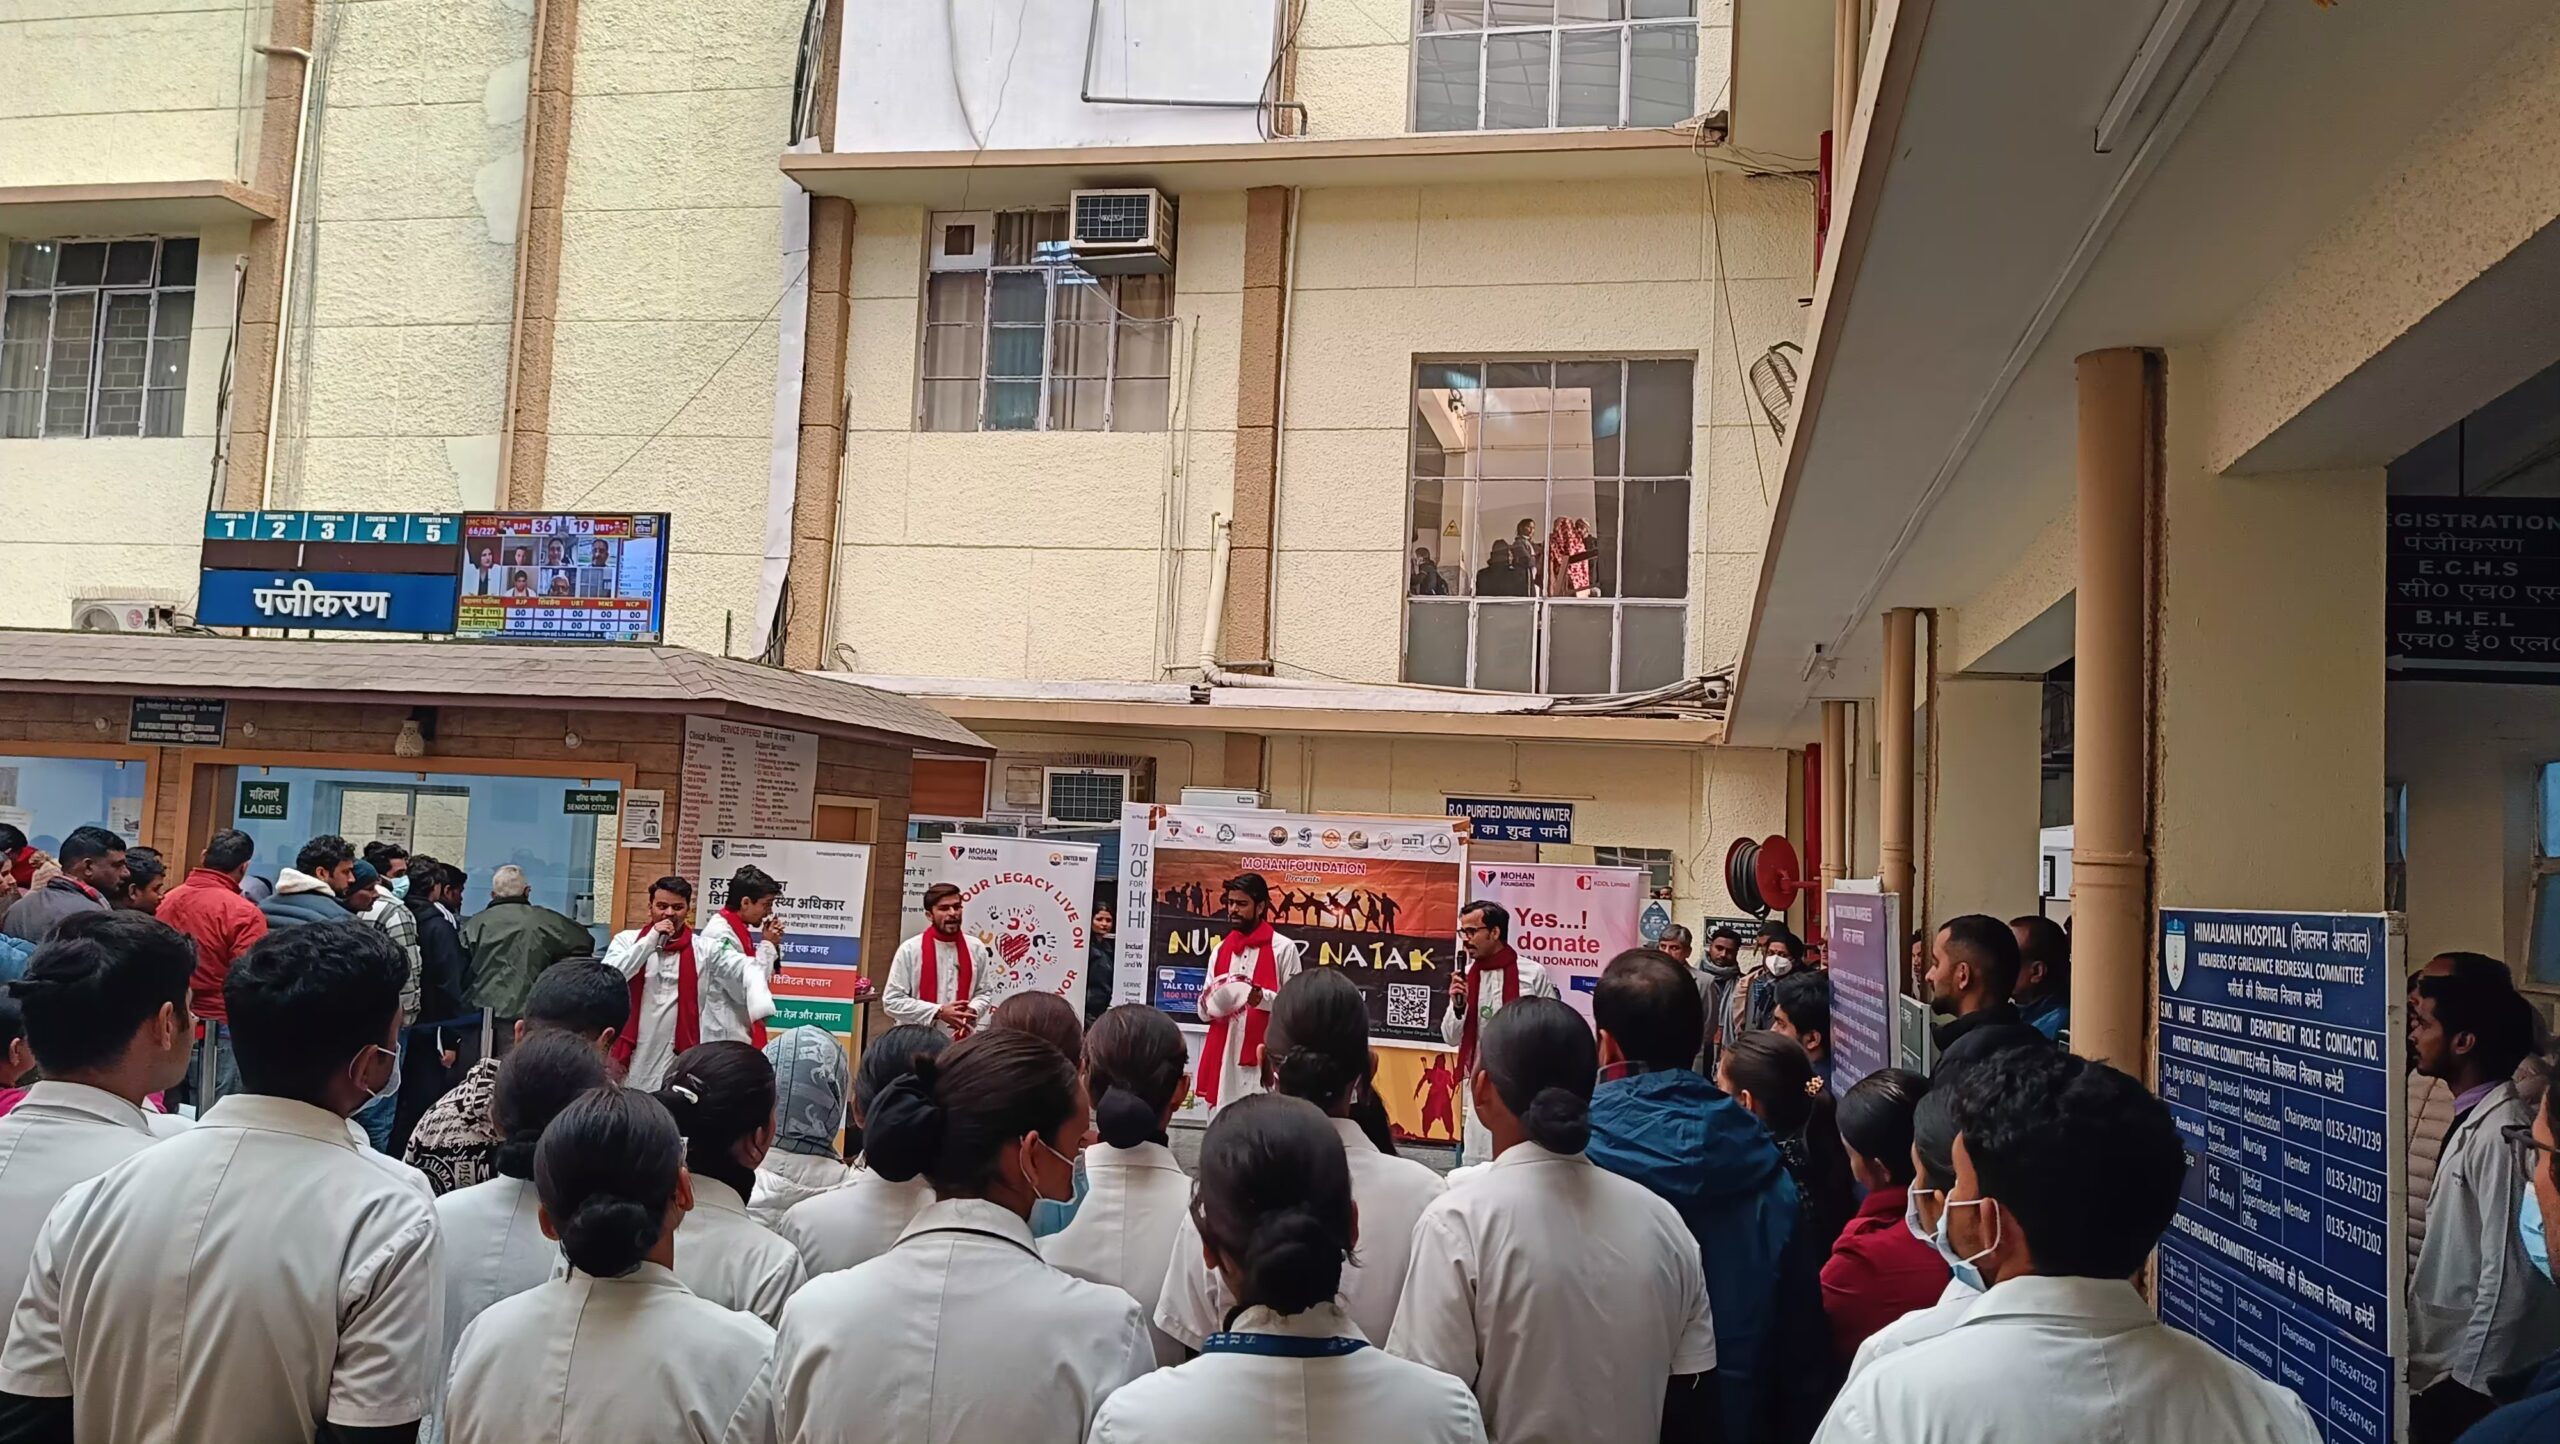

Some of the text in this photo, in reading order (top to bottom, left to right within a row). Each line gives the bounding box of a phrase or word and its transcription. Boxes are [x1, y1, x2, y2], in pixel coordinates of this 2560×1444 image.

[224, 520, 235, 537] 1
[272, 522, 286, 538] 2
[320, 522, 335, 540] 3
[372, 524, 387, 540] 4
[426, 525, 440, 542] 5
[535, 520, 552, 532] 36
[574, 521, 590, 532] 19
[2404, 532, 2525, 554] पंजीकरण
[2418, 560, 2518, 577] E.C.H.S
[254, 579, 392, 619] पंजीकरण
[572, 610, 584, 618] 00
[2416, 610, 2515, 627] B.H.E.L
[600, 622, 611, 630] 00
[244, 804, 282, 814] LADIES
[591, 804, 616, 812] CITIZEN
[1448, 804, 1570, 822] R.O. PURIFIED DRINKING WATER
[1481, 824, 1568, 840] का शुद्ध पानी
[968, 847, 998, 856] MOHAN
[1242, 857, 1366, 876] MOHAN FOUNDATION
[1500, 872, 1536, 881] MOHAN
[709, 878, 724, 889] हर
[1284, 873, 1321, 884] Presents
[798, 895, 846, 911] अधिकार
[960, 879, 991, 903] OUR
[994, 872, 1054, 893] LEGACY
[1054, 890, 1080, 923] LIVE
[1072, 926, 1085, 950] ON
[1514, 907, 1588, 930] Yes...!
[795, 944, 830, 956] एक जगह
[1517, 931, 1600, 954] donate
[2194, 922, 2371, 960] HIMALAYAN HOSPITAL (हिमालयन अस्पताल)
[1318, 942, 1436, 972] NATAK
[1544, 956, 1599, 968] DONATION
[2198, 952, 2364, 986] MEMBERS OF GRIEVANCE REDRESSAL COMMITTEE
[774, 974, 832, 988] डिजिटल पहचान
[1162, 982, 1182, 990] TALK
[2245, 979, 2253, 1000] की
[2255, 980, 2278, 1003] शिकायत
[2280, 984, 2302, 1007] निवारण
[2304, 988, 2322, 1010] कमेटी
[798, 1008, 814, 1020] और
[814, 1012, 842, 1022] आसान
[2160, 1002, 2379, 1061] S.NO. NAME DESIGNATION DEPARTMENT ROLE CONTACT NO.
[2172, 1034, 2192, 1053] PATIENT
[2192, 1038, 2220, 1061] GRIEVANCE
[2272, 1052, 2296, 1082] शिकायत
[2298, 1058, 2322, 1090] निवारण
[2324, 1068, 2345, 1094] कमेटी
[2173, 1064, 2186, 1085] (Brig)
[2186, 1068, 2192, 1084] RS
[2192, 1070, 2206, 1088] SAINI
[2208, 1076, 2240, 1098] Deputy Medical
[2243, 1084, 2270, 1106] Hospital
[2208, 1095, 2240, 1118] Superintendent
[2176, 1116, 2192, 1134] Reena
[2244, 1108, 2280, 1133] Administration
[2284, 1106, 2322, 1133] Chairperson
[2208, 1120, 2226, 1142] Nursing
[2326, 1118, 2382, 1152] 0135-2471239
[2207, 1140, 2240, 1162] Superintendent
[2243, 1136, 2267, 1162] Nursing
[2208, 1163, 2220, 1182] PCE
[2284, 1151, 2310, 1176] Member
[2242, 1170, 2262, 1192] Medical
[2326, 1166, 2382, 1204] 0135-2471237
[2208, 1184, 2235, 1211] (On duty)
[2242, 1189, 2281, 1220] Superintendent
[2242, 1211, 2258, 1232] Office
[2284, 1198, 2310, 1224] Member
[2326, 1214, 2382, 1256] 0135-2471202
[2190, 1221, 2220, 1250] GRIEVANCE
[2287, 1267, 2296, 1288] की
[2298, 1270, 2324, 1305] शिकायत
[2326, 1284, 2352, 1320] निवारण
[2354, 1300, 2376, 1332] कमेटी
[2249, 1302, 2262, 1320] Office
[2282, 1322, 2316, 1353] Chairperson
[2282, 1360, 2304, 1386] Member
[2330, 1354, 2377, 1394] 0135-2471232
[2330, 1396, 2376, 1438] 0135-2471421
